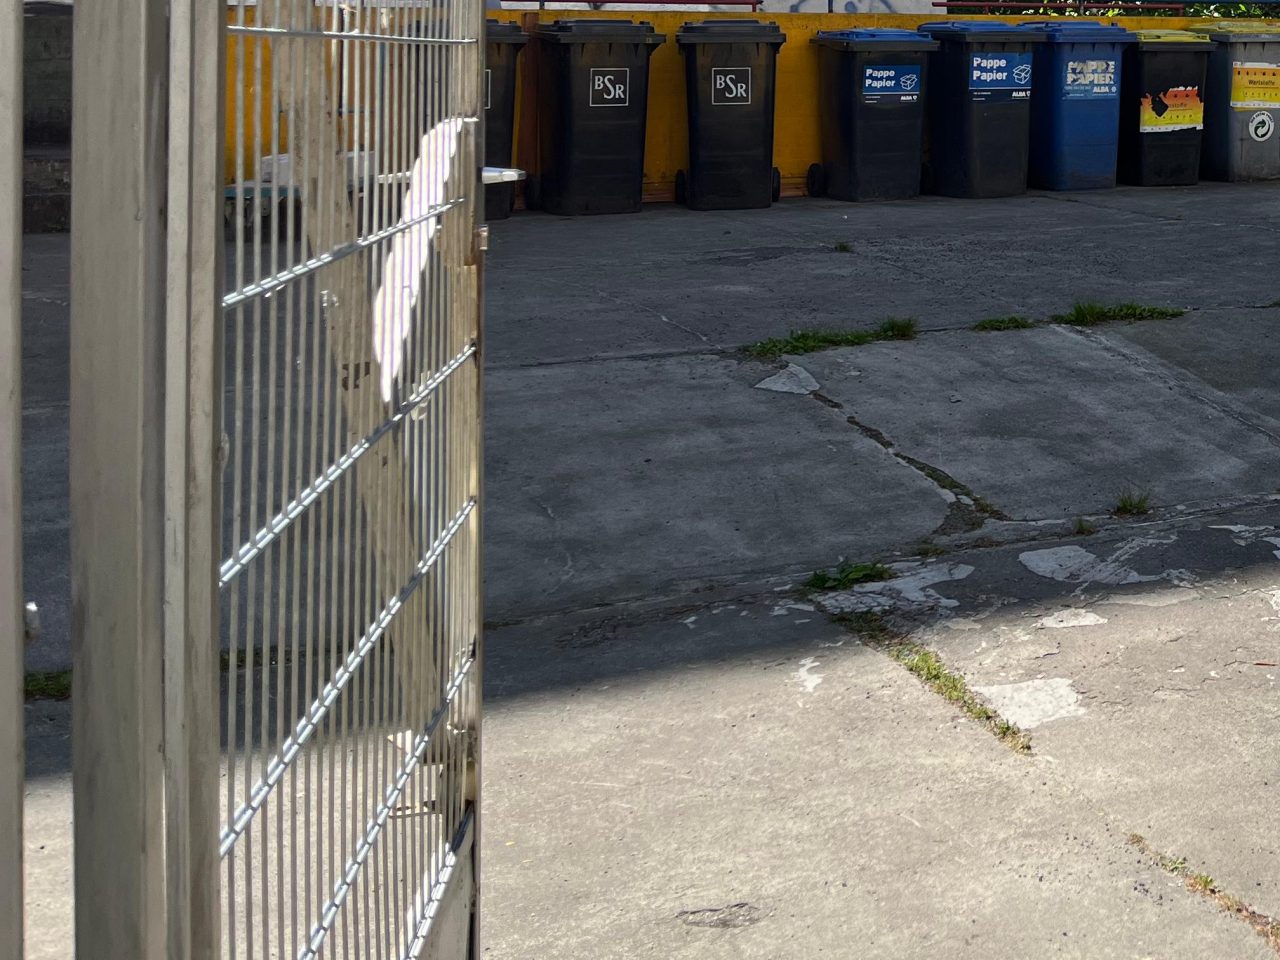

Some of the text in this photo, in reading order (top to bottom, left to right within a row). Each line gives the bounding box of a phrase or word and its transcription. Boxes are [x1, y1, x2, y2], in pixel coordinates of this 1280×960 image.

[973, 57, 1007, 69] Pappe
[865, 68, 895, 78] Pappe
[973, 70, 1008, 82] Papier
[1066, 73, 1115, 85] PAPIER
[594, 75, 625, 99] BSR
[716, 74, 747, 98] BSR
[865, 79, 896, 88] Papier
